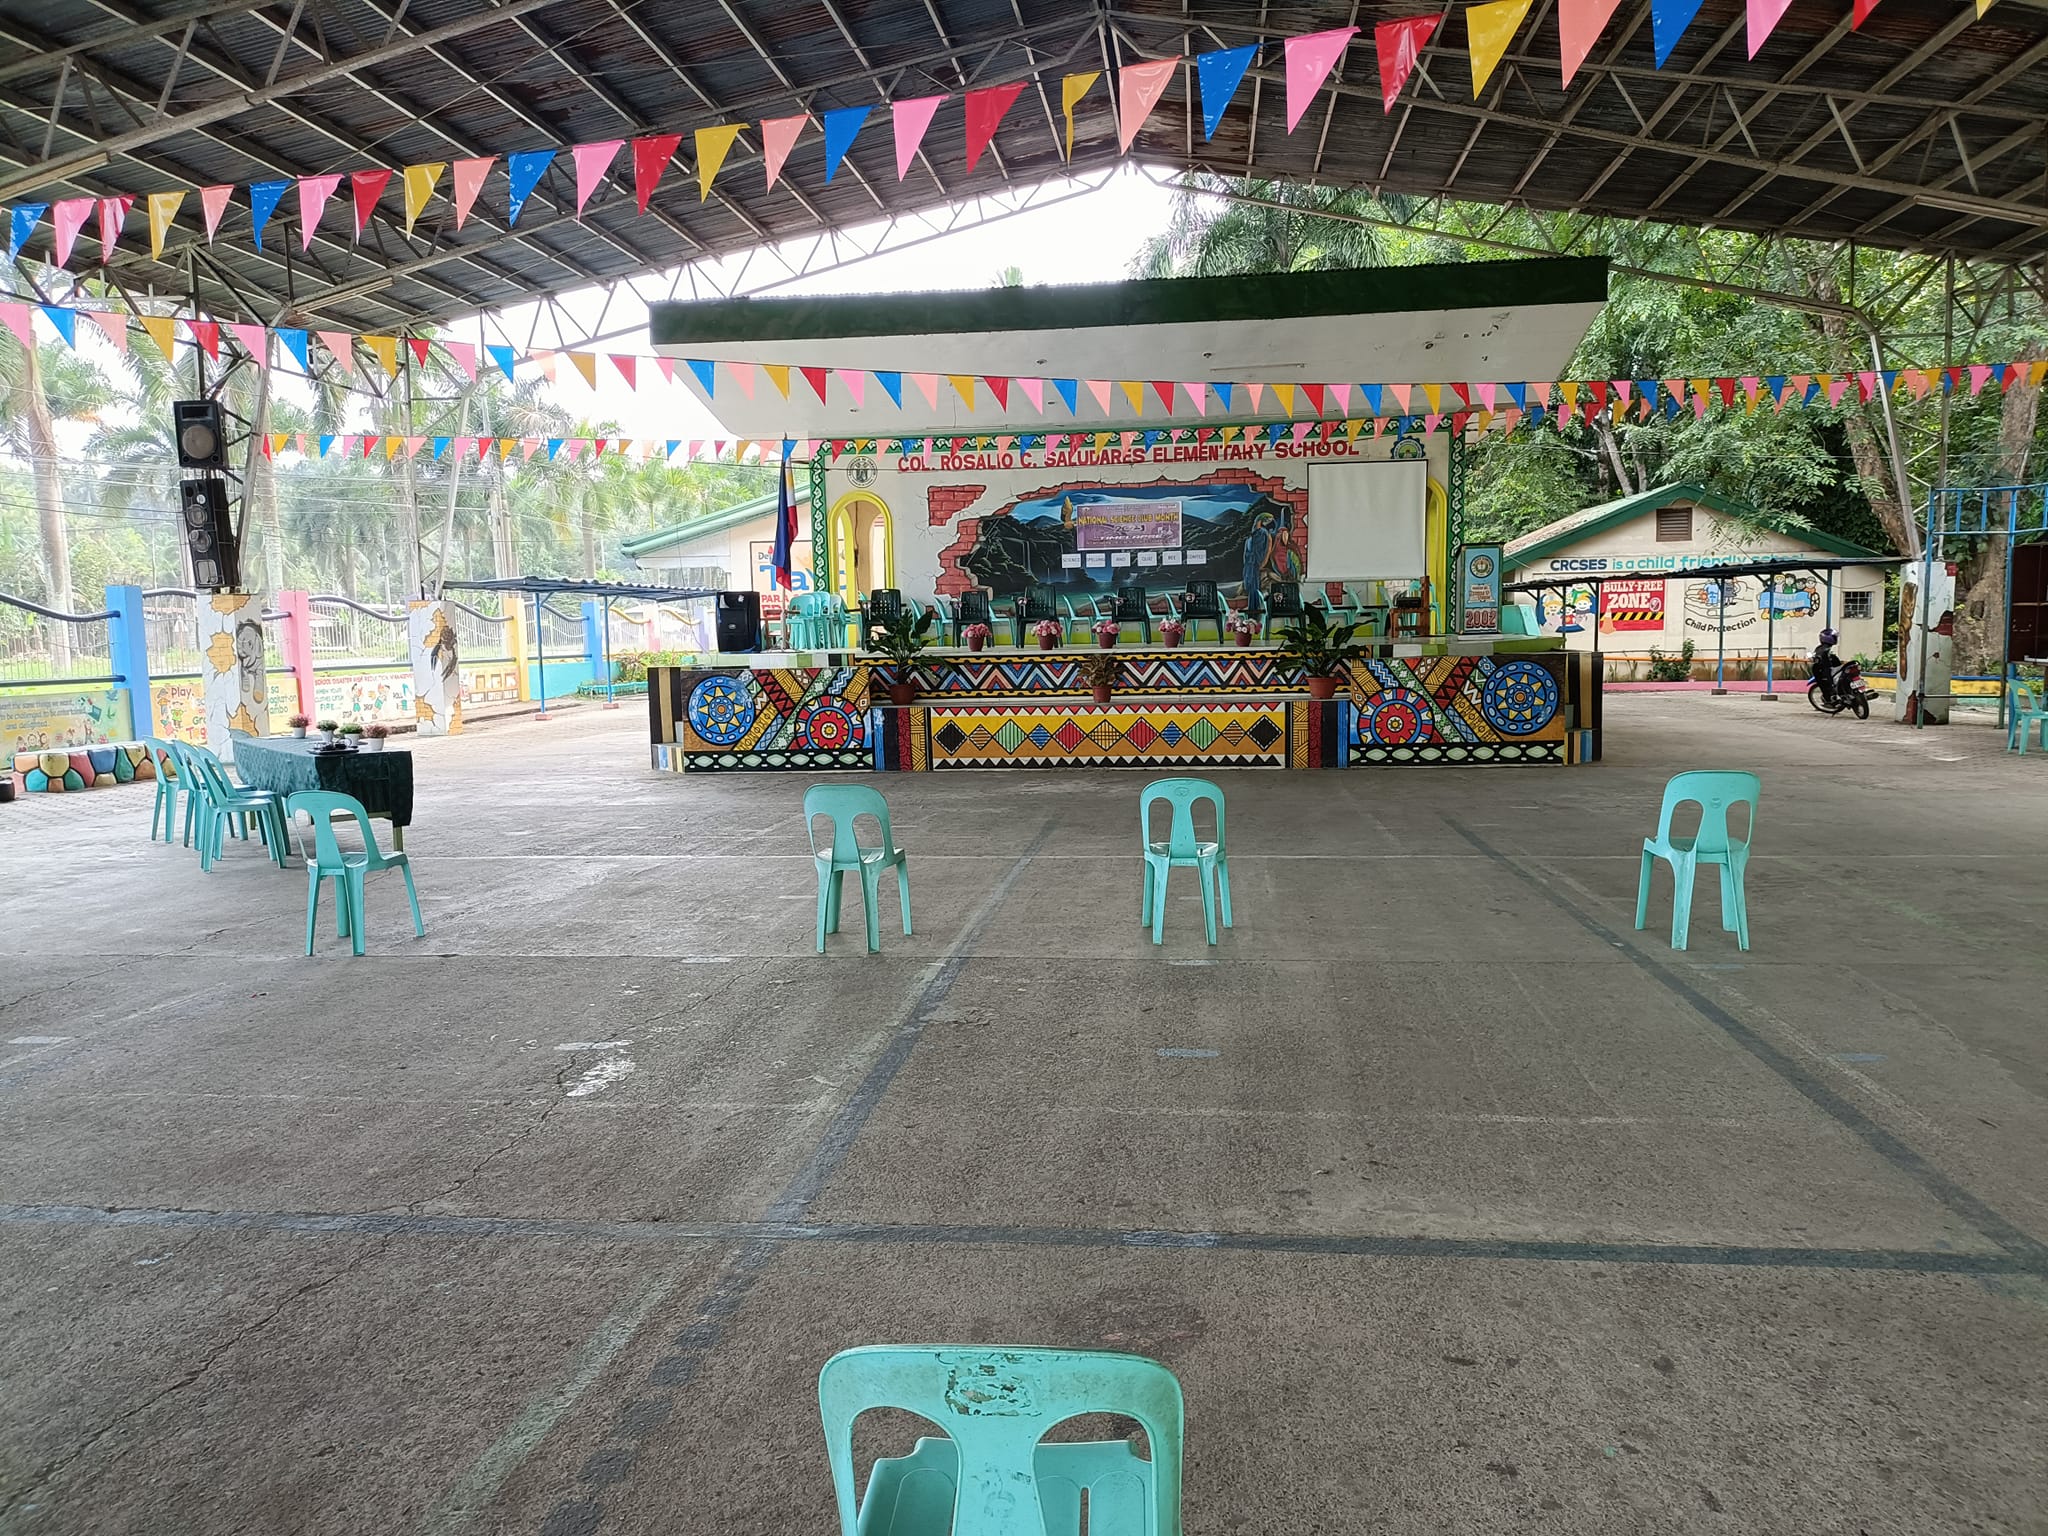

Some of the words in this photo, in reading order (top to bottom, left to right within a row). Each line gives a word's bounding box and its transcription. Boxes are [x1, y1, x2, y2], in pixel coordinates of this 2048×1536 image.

[898, 456, 936, 472] COL.
[941, 453, 1013, 471] ROSALIO
[1020, 452, 1037, 468] C.
[1044, 447, 1145, 467] SALUDARES
[1153, 444, 1266, 463] ELEMENTARY
[1275, 440, 1359, 458] SCHOOL
[1079, 515, 1107, 526] NATIONAL
[1110, 514, 1135, 524] SCIENCE
[1139, 513, 1153, 523] CLUB
[1155, 511, 1180, 522] MONTH
[1550, 559, 1607, 571] CRCSES
[1612, 558, 1623, 570] is
[1625, 560, 1634, 569] a
[1638, 556, 1675, 569] child
[1603, 581, 1663, 592] BULLY-FREE
[1608, 592, 1650, 609] ZONE
[1466, 610, 1496, 627] 2002
[1685, 617, 1707, 631] Child
